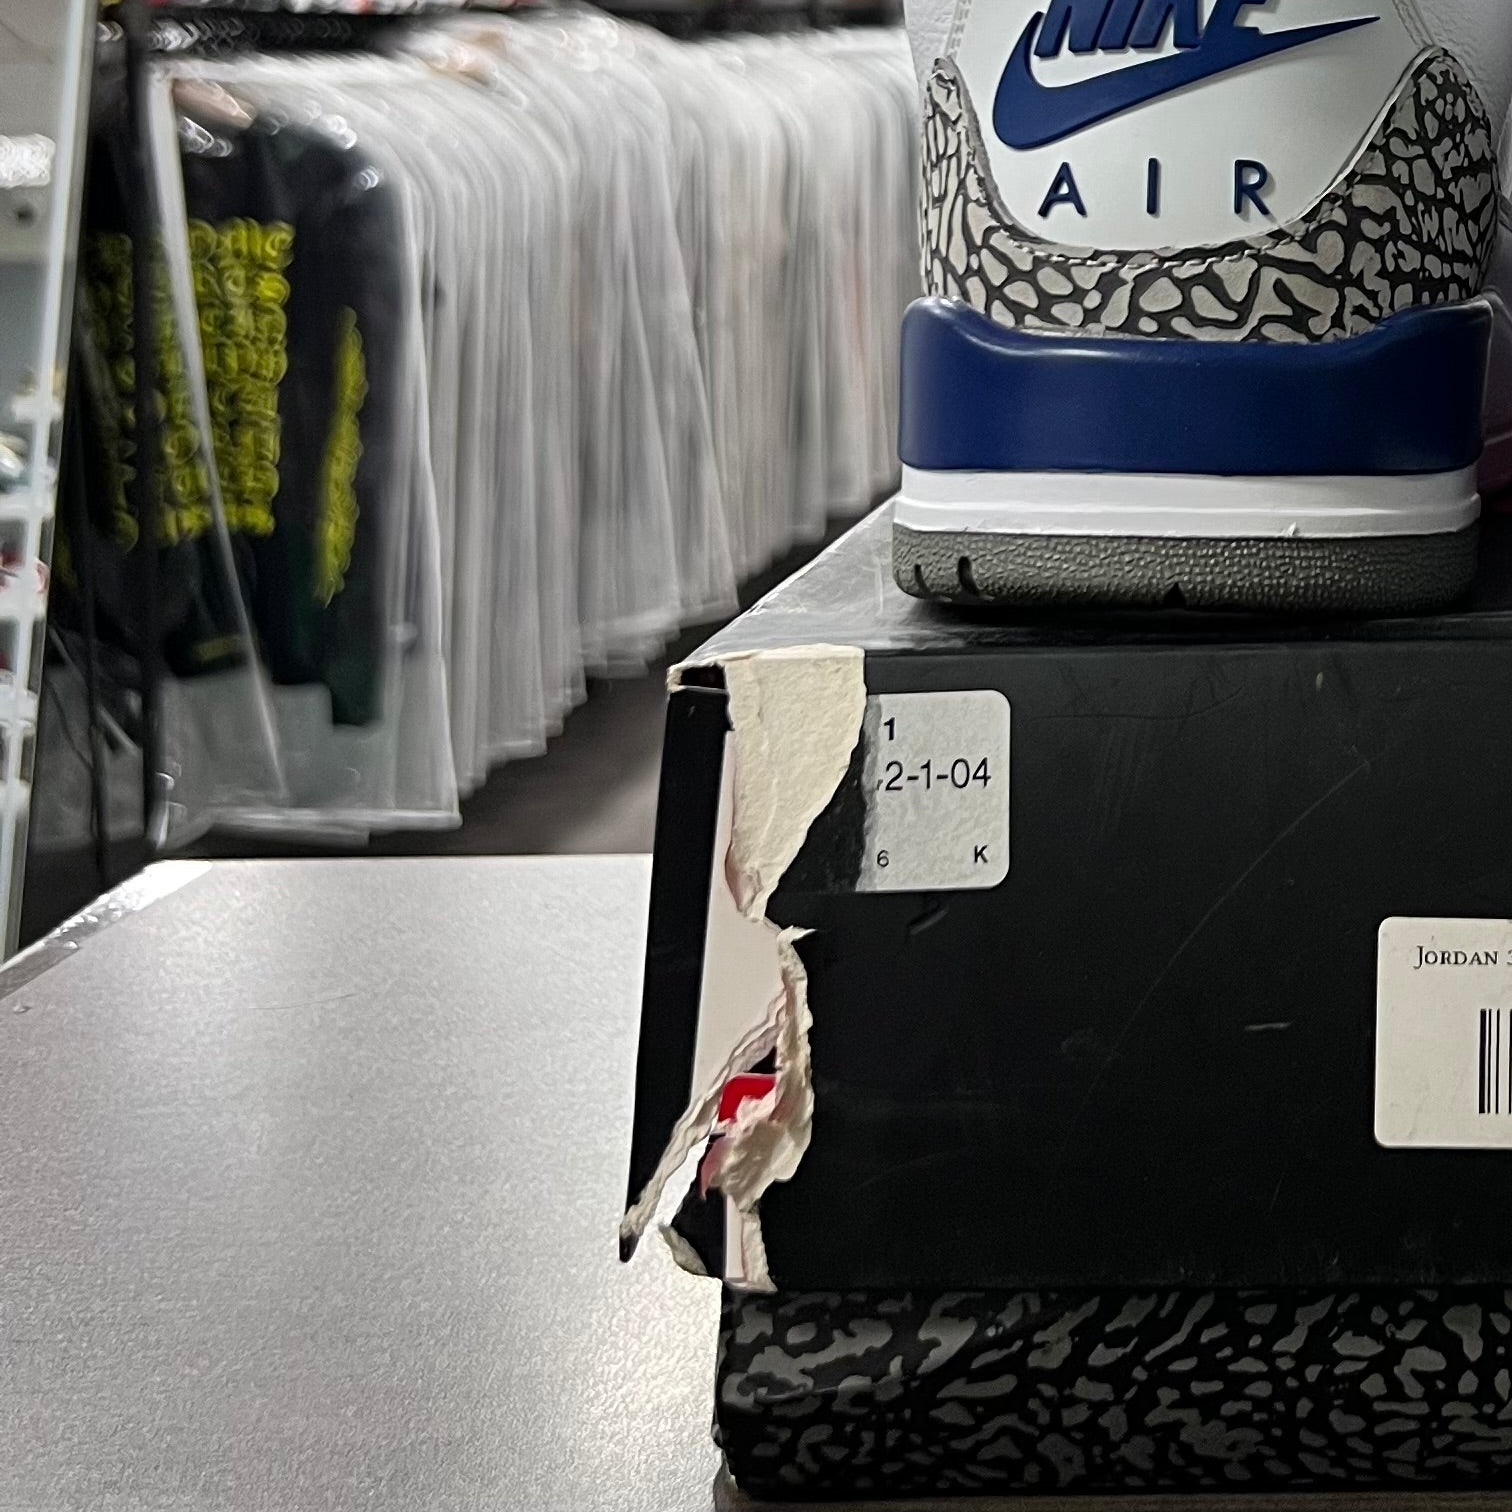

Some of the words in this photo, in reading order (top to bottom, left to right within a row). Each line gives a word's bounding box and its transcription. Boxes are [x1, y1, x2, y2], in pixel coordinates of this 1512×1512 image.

[1037, 157, 1272, 218] AIR
[883, 716, 896, 741] 1
[877, 756, 992, 792] 2-1-04
[876, 849, 890, 868] 6
[973, 844, 989, 864] K
